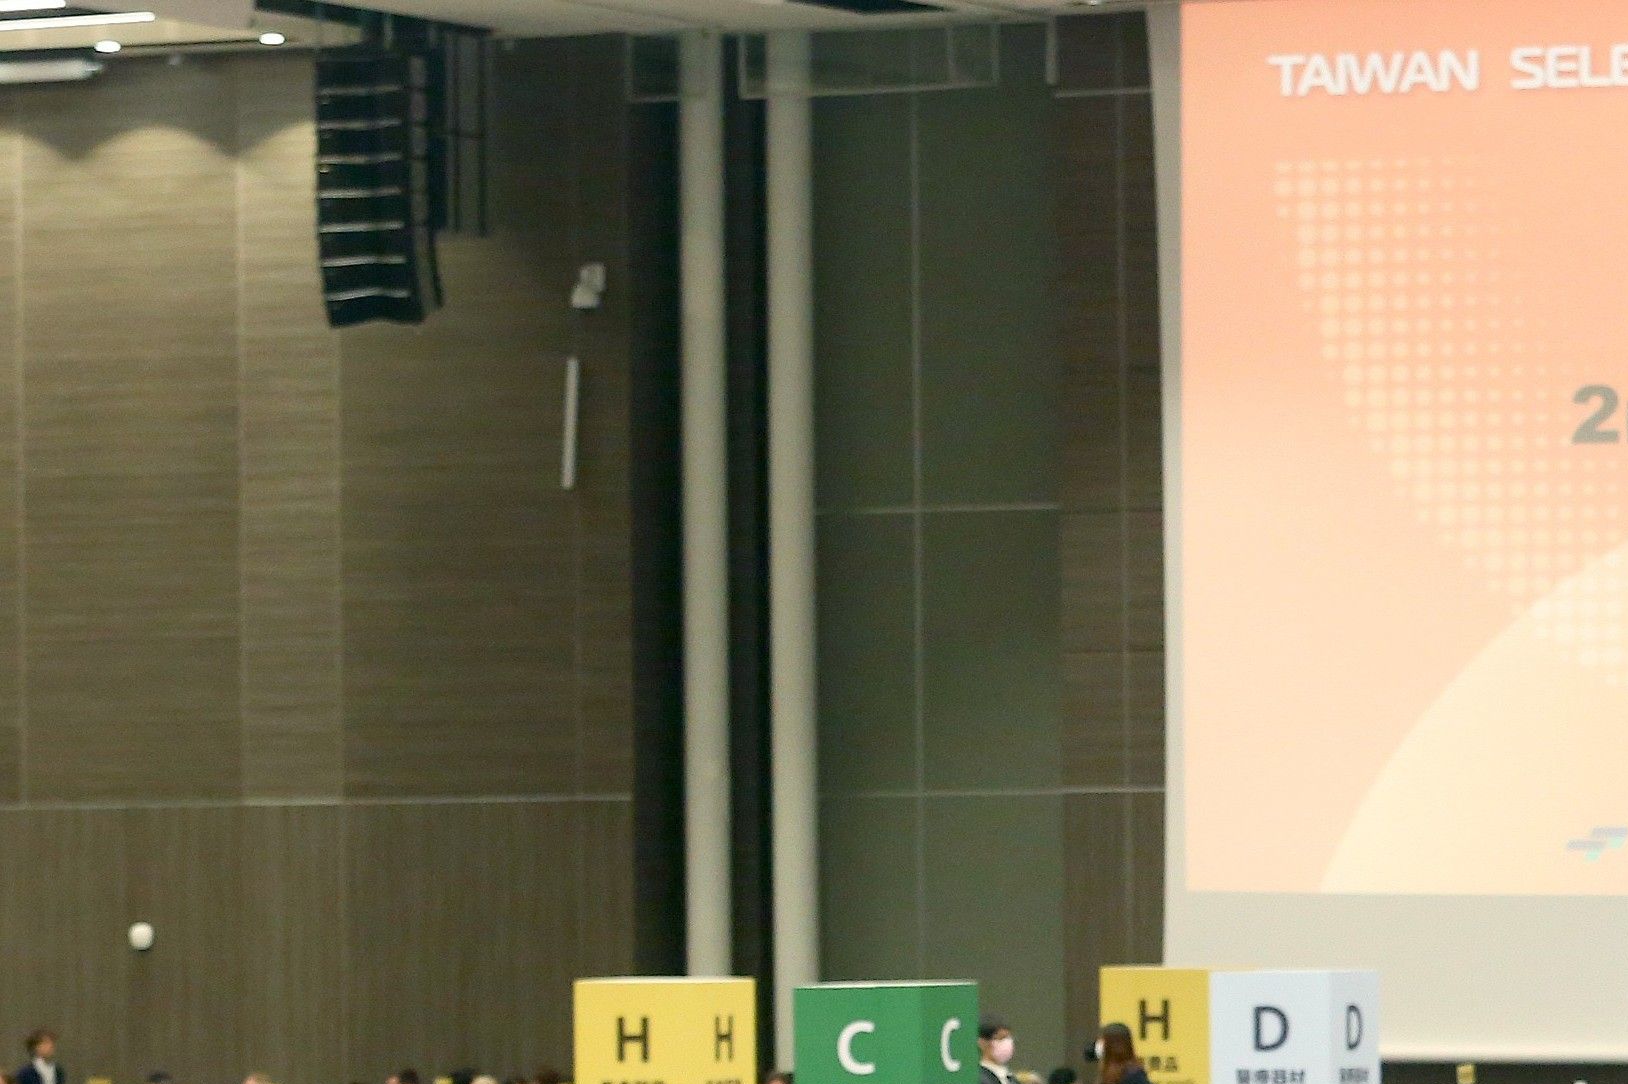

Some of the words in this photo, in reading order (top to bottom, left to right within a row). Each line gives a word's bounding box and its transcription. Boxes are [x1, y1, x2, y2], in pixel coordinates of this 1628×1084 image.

[1267, 50, 1480, 97] TAIWAN
[616, 1015, 650, 1063] H
[714, 1015, 734, 1062] H
[1138, 999, 1169, 1041] H
[1254, 1005, 1289, 1051] D
[1346, 1004, 1363, 1050] D
[836, 1019, 877, 1075] C
[940, 1017, 962, 1073] C
